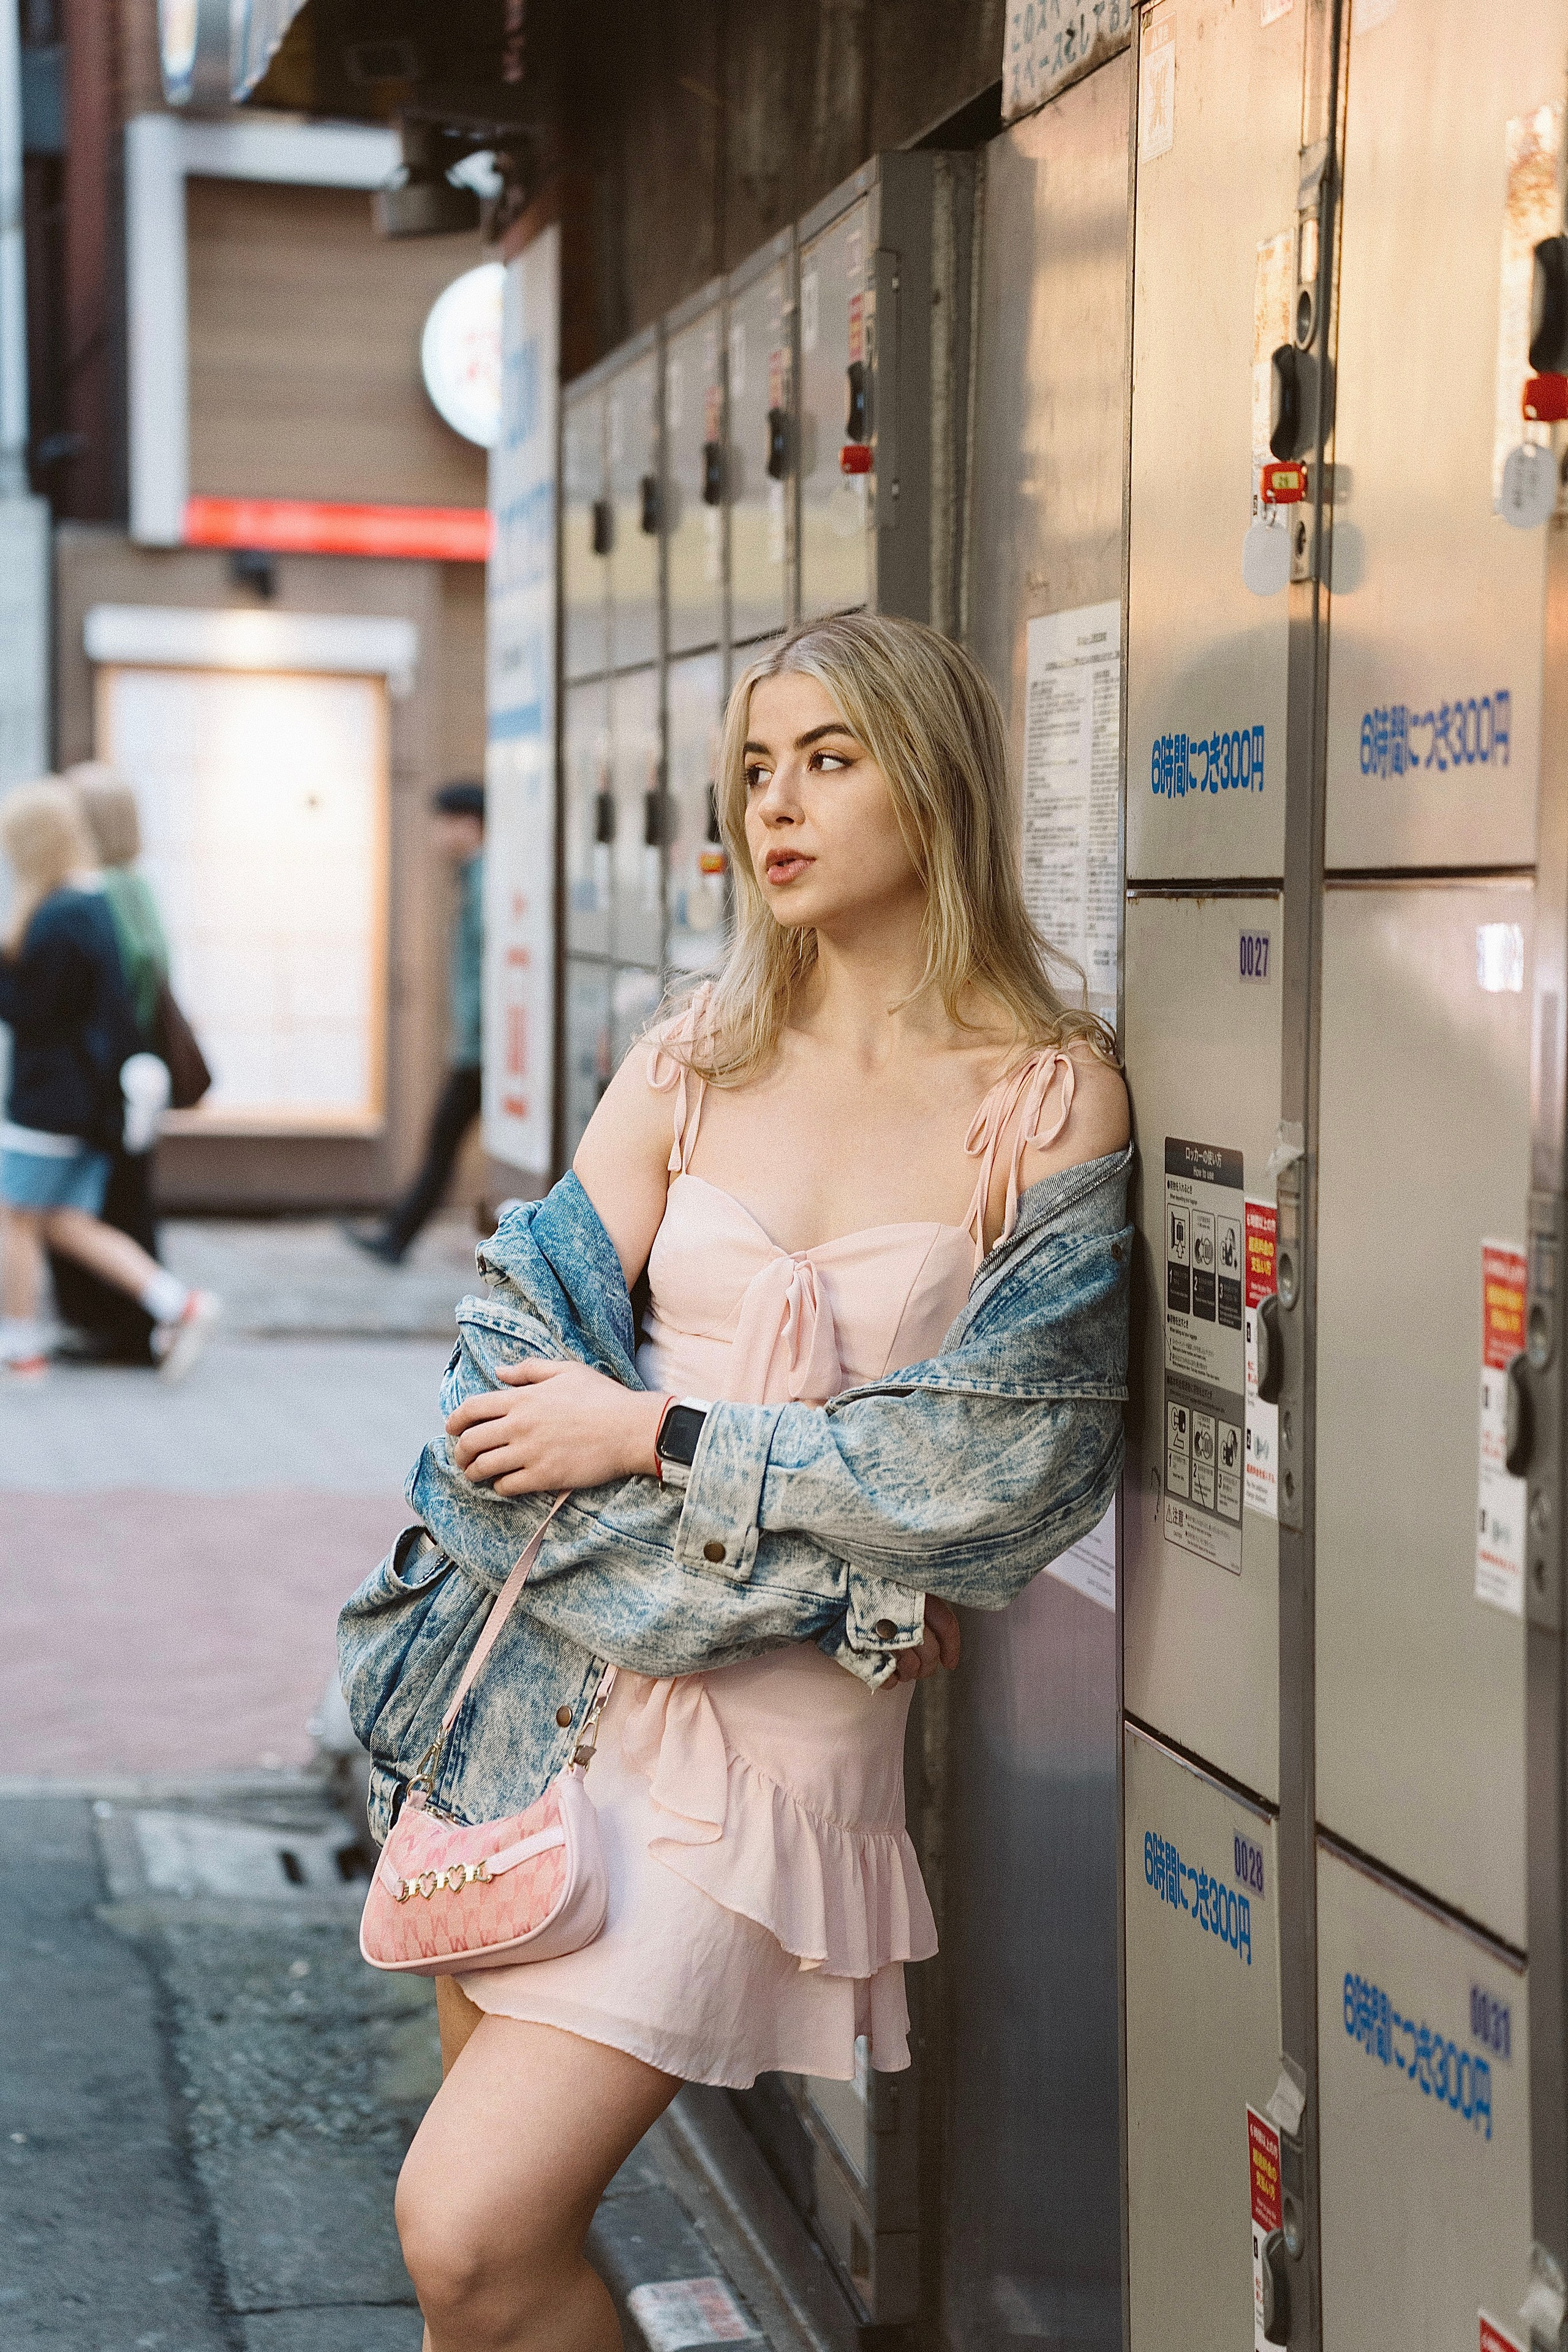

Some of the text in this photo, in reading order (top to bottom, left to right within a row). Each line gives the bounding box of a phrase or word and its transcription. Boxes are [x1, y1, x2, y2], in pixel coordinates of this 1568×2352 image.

[1360, 689, 1511, 778] 6時間につき300円
[1151, 725, 1265, 799] 6時間につき300円
[1240, 936, 1269, 978] 0027
[1185, 1147, 1222, 1168] ロッカーの使い方
[1193, 1166, 1202, 1177] How
[1169, 1268, 1172, 1284] 1
[1194, 1275, 1199, 1291] 2
[1219, 1282, 1223, 1299] 3
[1169, 1452, 1172, 1468] 1
[1194, 1463, 1197, 1478] 2
[1219, 1473, 1223, 1488] 3
[1172, 1507, 1184, 1528] 注意
[1234, 1837, 1263, 1891] 0028
[1144, 1831, 1251, 1965] 6時間につき300円
[1343, 1973, 1492, 2140] 6時間につき300円
